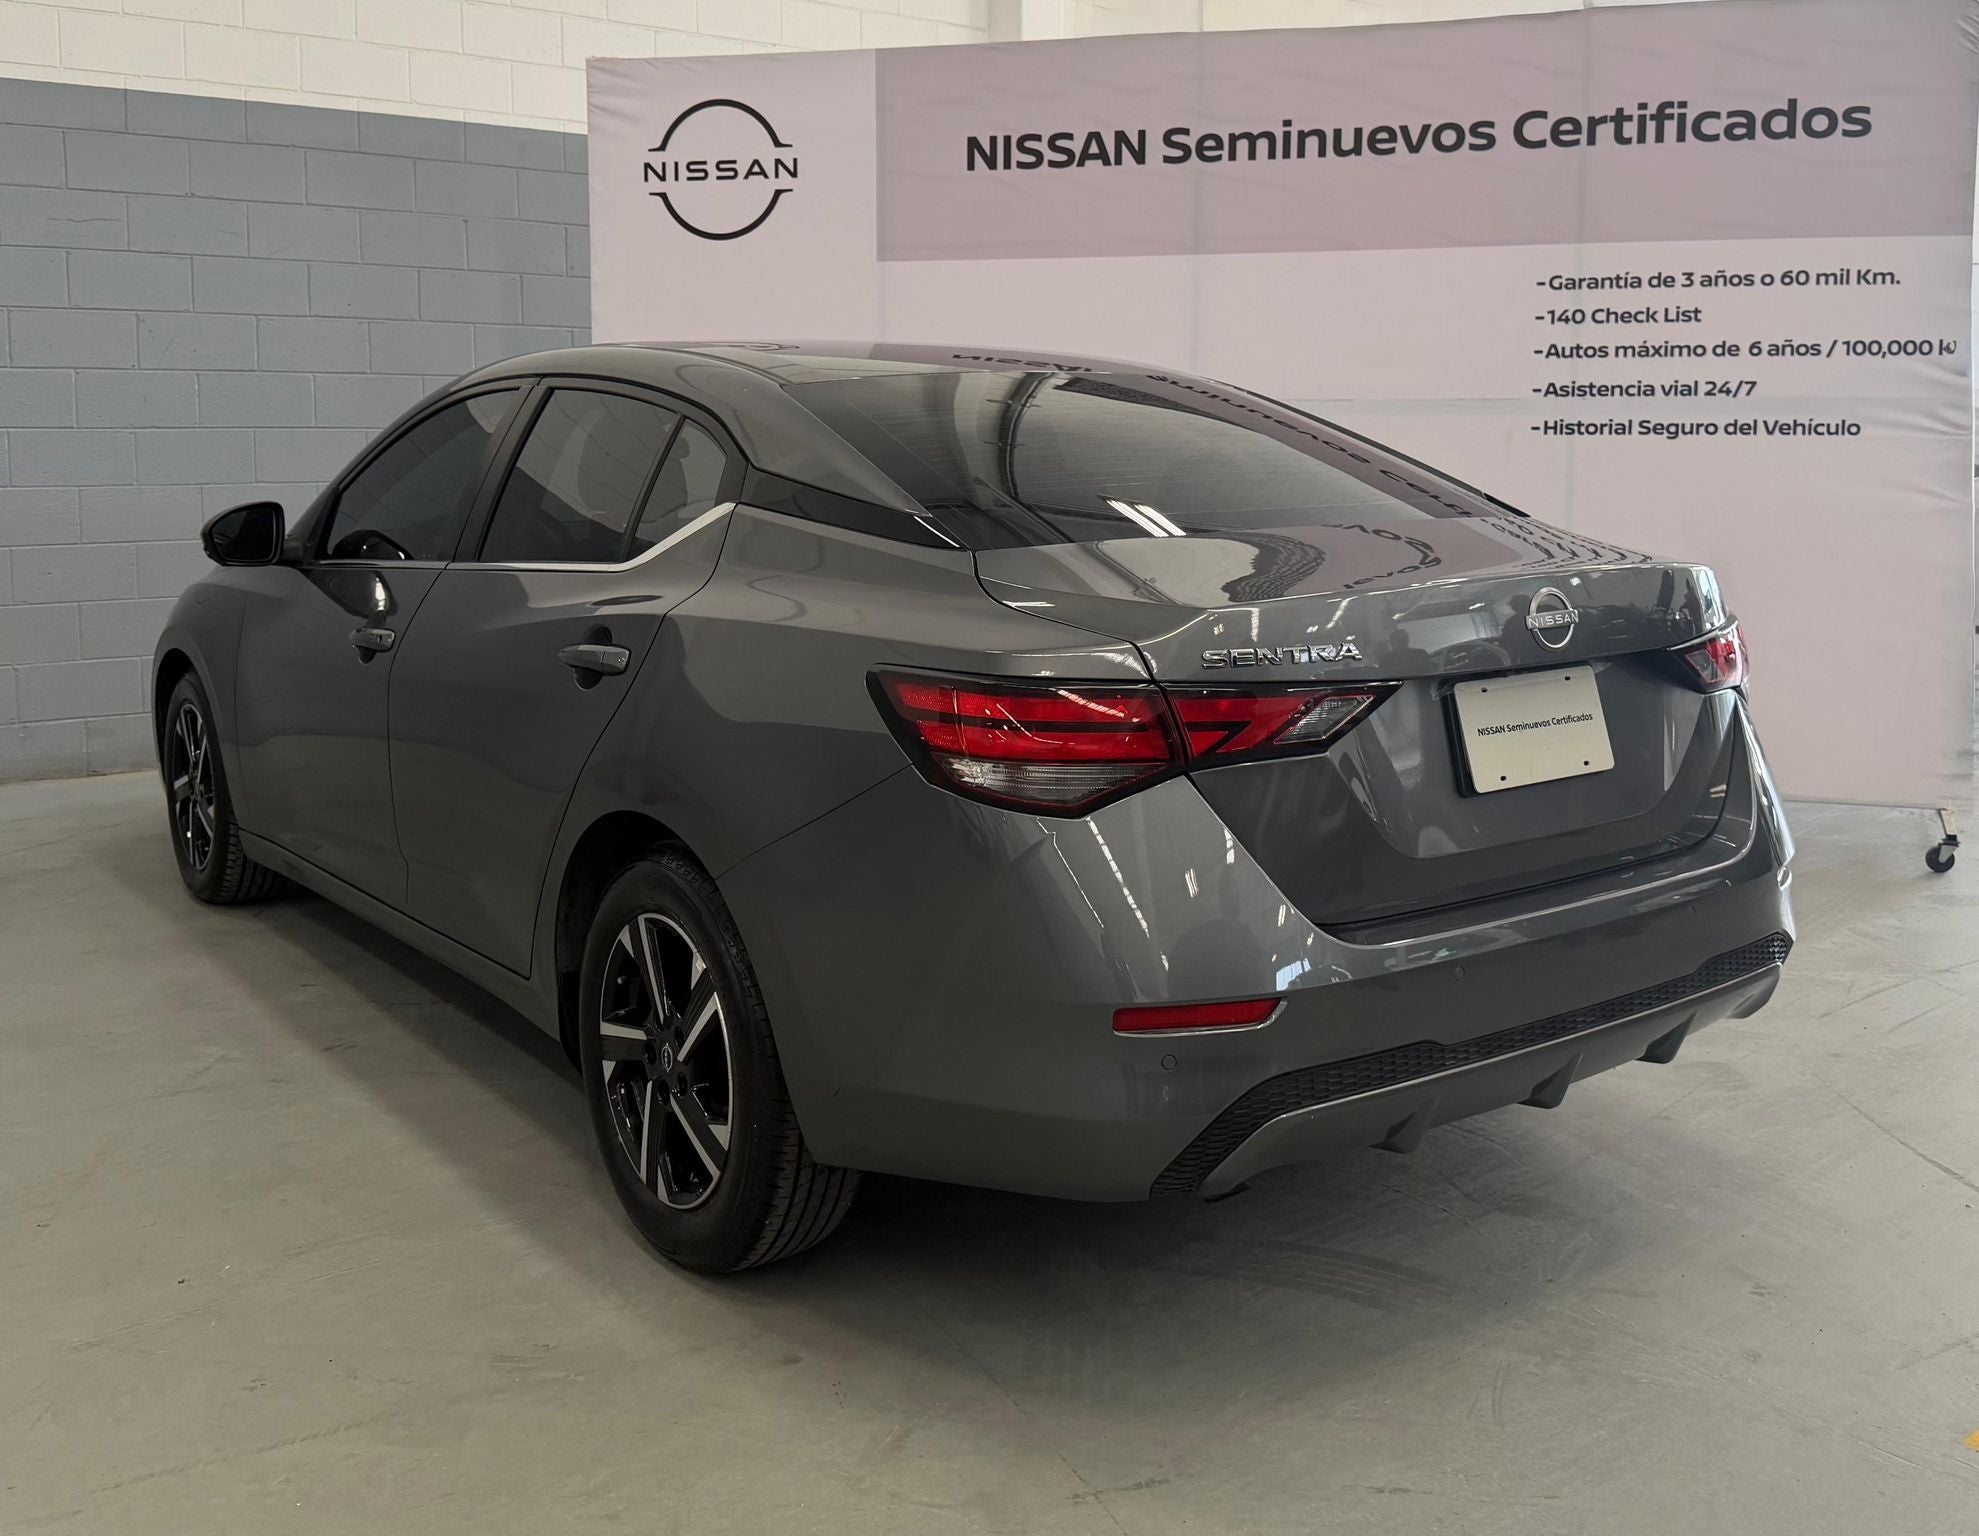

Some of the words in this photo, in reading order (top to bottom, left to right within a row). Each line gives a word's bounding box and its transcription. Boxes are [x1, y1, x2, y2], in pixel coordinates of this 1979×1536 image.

[966, 129, 1147, 172] NISSAN
[1162, 119, 1497, 165] Seminuevos
[1512, 97, 1872, 150] Certificados
[643, 156, 799, 183] NISSAN
[1536, 271, 1643, 291] -Garantía
[1647, 271, 1676, 289] de
[1680, 271, 1695, 288] 3
[1699, 269, 1755, 288] años
[1760, 273, 1775, 287] o
[1780, 269, 1810, 287] 60
[1815, 267, 1851, 286] mil
[1856, 268, 1901, 286] Km.
[1534, 308, 1586, 325] -140
[1590, 306, 1659, 325] Check
[1663, 305, 1702, 323] List
[1533, 342, 1609, 359] -Autos
[1614, 340, 1707, 358] máximo
[1711, 340, 1741, 358] de
[1748, 340, 1763, 357] 6
[1766, 339, 1822, 357] años
[1825, 339, 1838, 358] /
[1841, 339, 1934, 359] 100,000
[1531, 379, 1656, 398] -Asistencia
[1660, 379, 1699, 397] vial
[1703, 380, 1758, 399] 24/7
[1530, 418, 1633, 436] -Historial
[1637, 419, 1719, 440] Seguro
[1723, 418, 1758, 436] del
[1762, 418, 1861, 436] Vehículo
[1528, 609, 1579, 629] NISSAN
[1202, 643, 1363, 669] SENTRA
[1477, 725, 1507, 737] NISSAN
[1507, 718, 1551, 733] Seminuevos
[1551, 712, 1594, 726] Certificados
